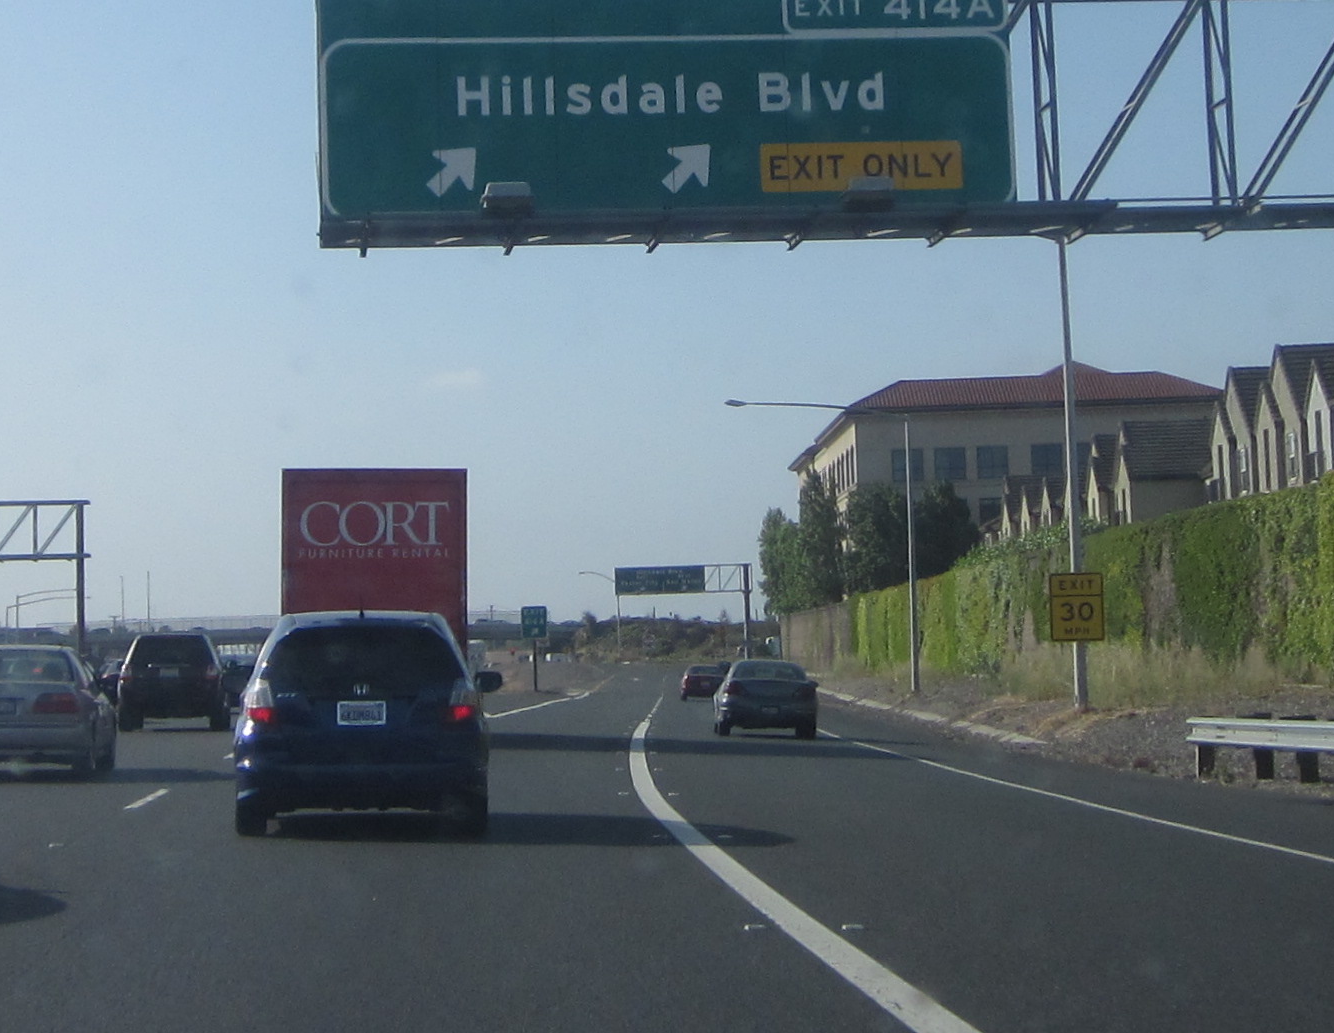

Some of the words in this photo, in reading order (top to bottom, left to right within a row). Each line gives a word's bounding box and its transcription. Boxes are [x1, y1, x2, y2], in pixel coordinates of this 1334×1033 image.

[456, 73, 723, 117] Hillsdale
[757, 70, 885, 113] Blvd
[769, 154, 845, 181] EXIT
[862, 151, 953, 178] ONLY
[299, 500, 451, 547] CORT
[298, 548, 384, 560] FURNITURE
[1058, 579, 1095, 592] EXIT
[1060, 601, 1095, 622] 30
[1064, 627, 1090, 635] MPH
